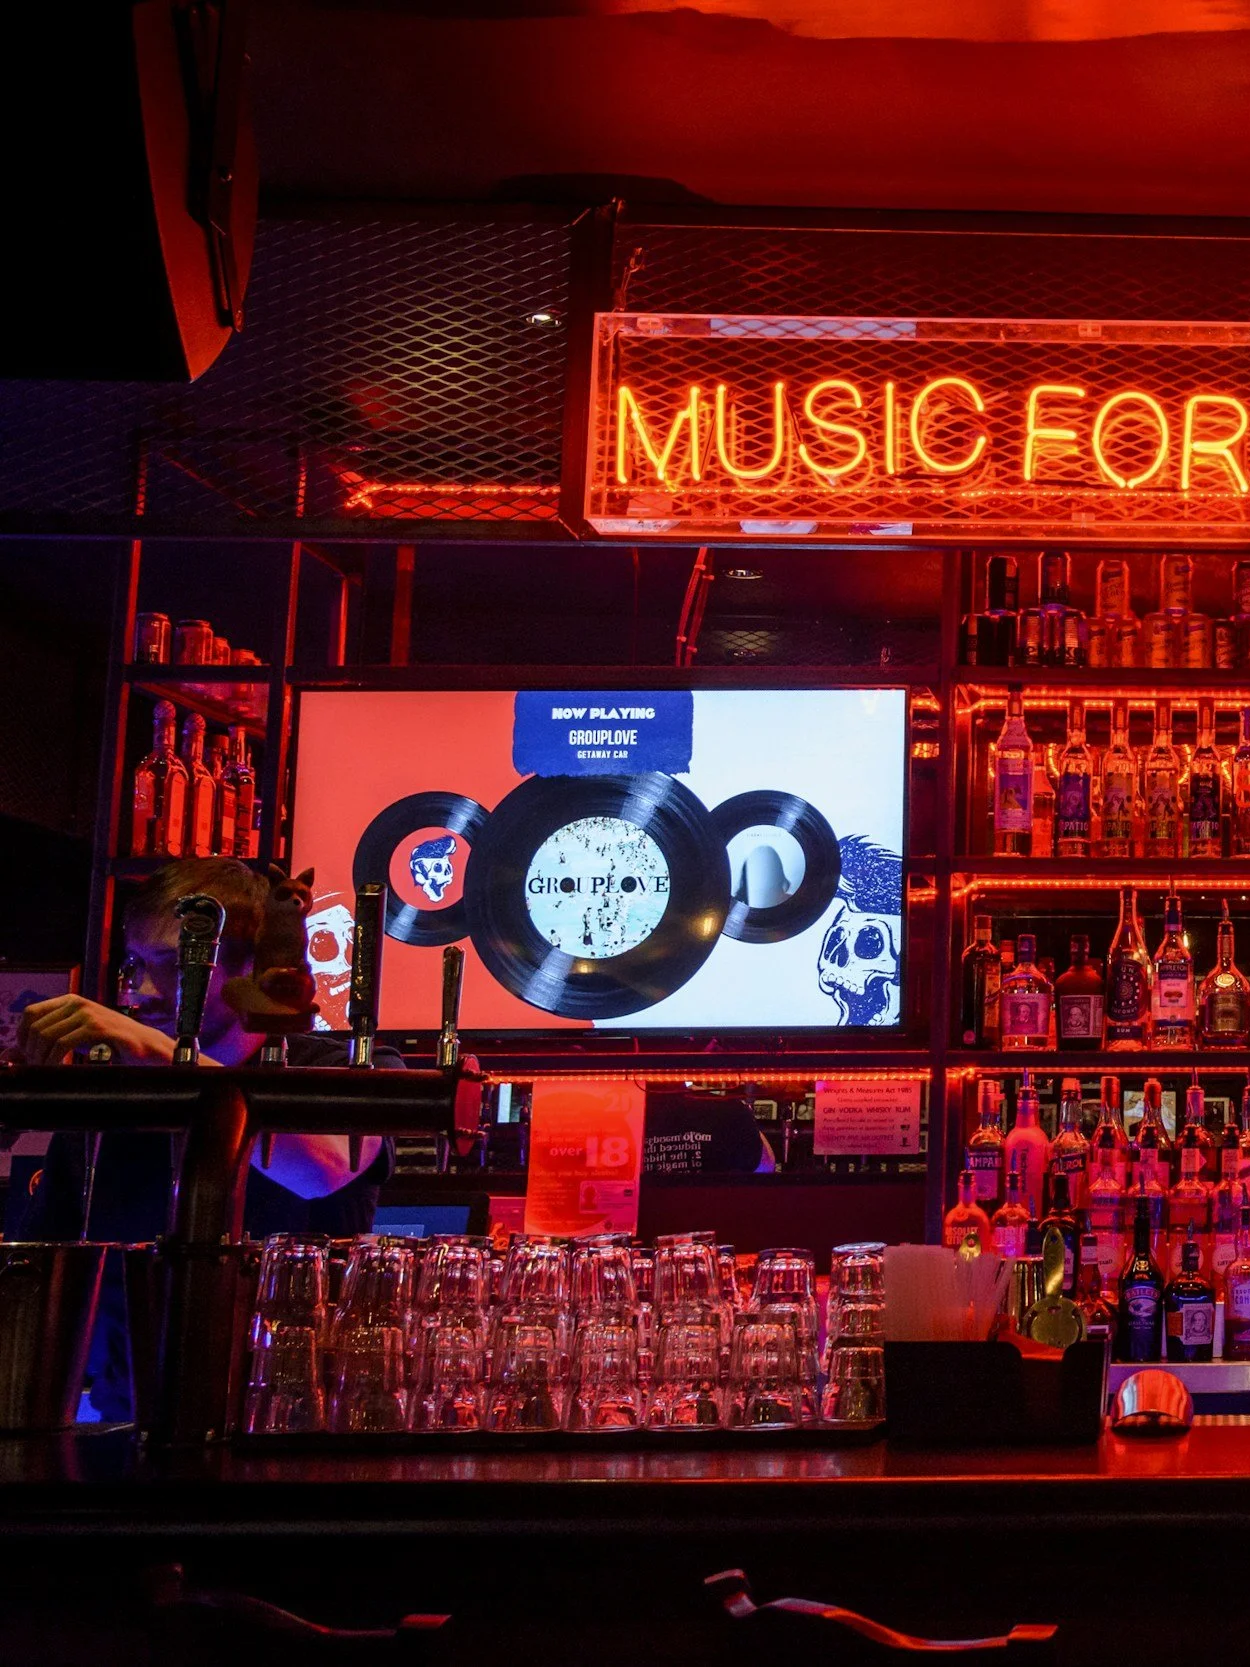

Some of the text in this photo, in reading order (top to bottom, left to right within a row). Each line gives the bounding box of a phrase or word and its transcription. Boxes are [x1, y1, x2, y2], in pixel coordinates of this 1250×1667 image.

[616, 376, 988, 484] MUSIC
[1022, 384, 1250, 494] FOR
[552, 708, 656, 720] NOW PLAYING
[569, 730, 638, 745] GROUPLOVE
[577, 751, 628, 759] GETAWAY CAR
[528, 876, 669, 894] GROUPLOVE
[550, 1146, 583, 1156] over
[585, 1136, 630, 1167] 18
